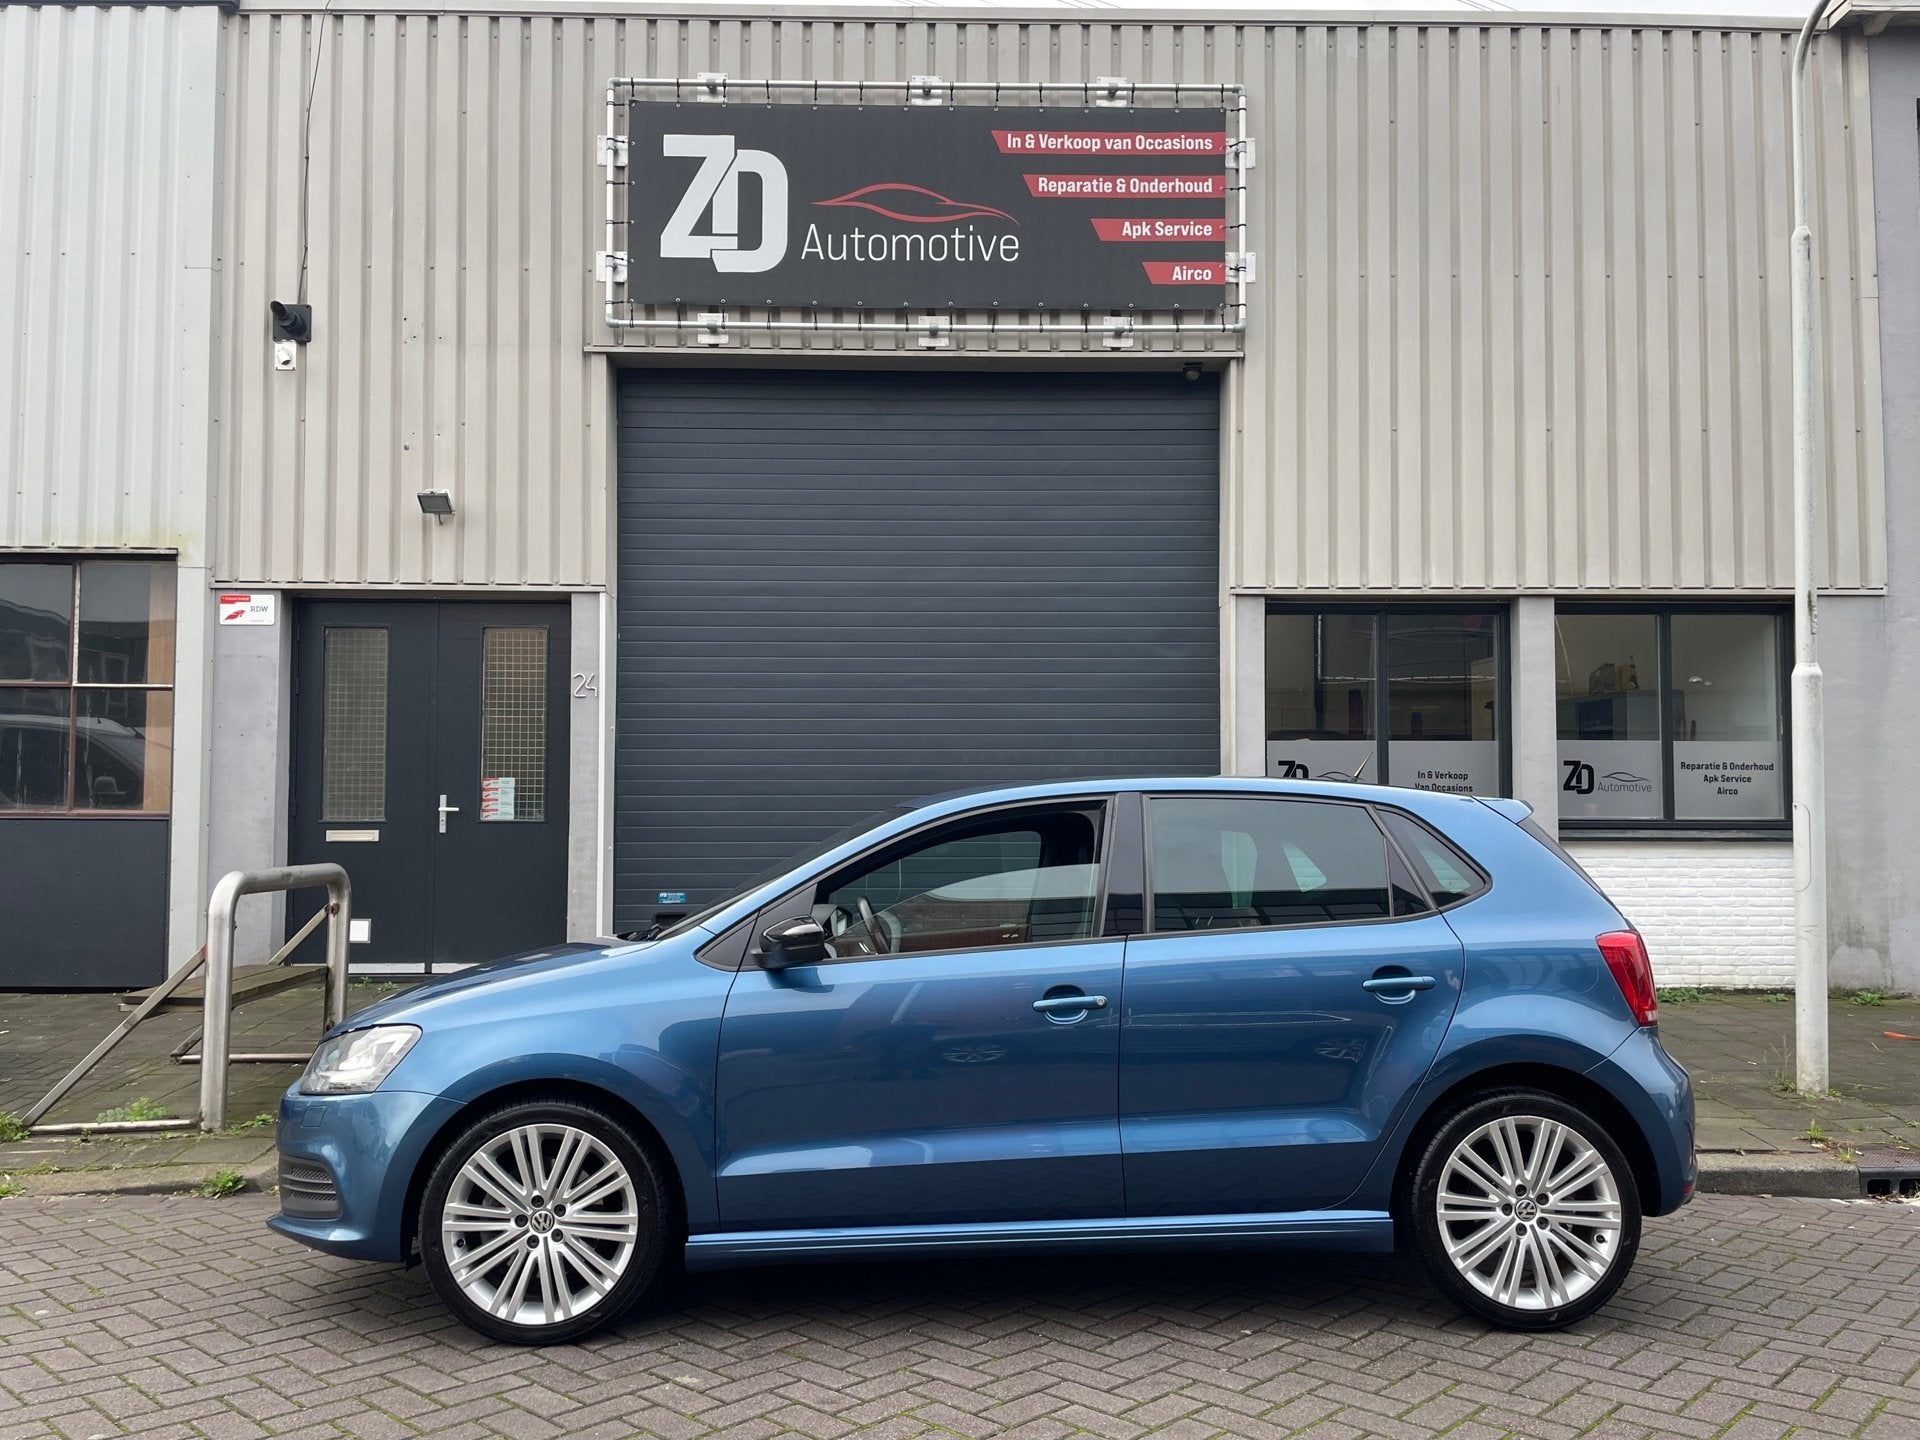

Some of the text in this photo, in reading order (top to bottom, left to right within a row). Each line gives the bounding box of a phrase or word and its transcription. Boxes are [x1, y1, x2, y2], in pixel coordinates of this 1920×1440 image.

[1007, 133, 1213, 152] In & Verkoop van Occasions
[1038, 177, 1213, 195] Reparatie & Onderhoud
[660, 134, 789, 273] ZD
[1121, 221, 1213, 239] Apk Service
[800, 223, 1020, 262] Automotive
[1171, 265, 1212, 281] Airco
[573, 672, 598, 698] 24
[1680, 761, 1774, 772] Reparatie & Onderhoud
[1417, 770, 1469, 781] In & Verkoop
[1562, 760, 1595, 795] ZD
[1703, 774, 1752, 784] Apk Service
[1431, 783, 1474, 793] Occasions
[1597, 782, 1652, 793] Automotive
[1716, 786, 1739, 796] Airco
